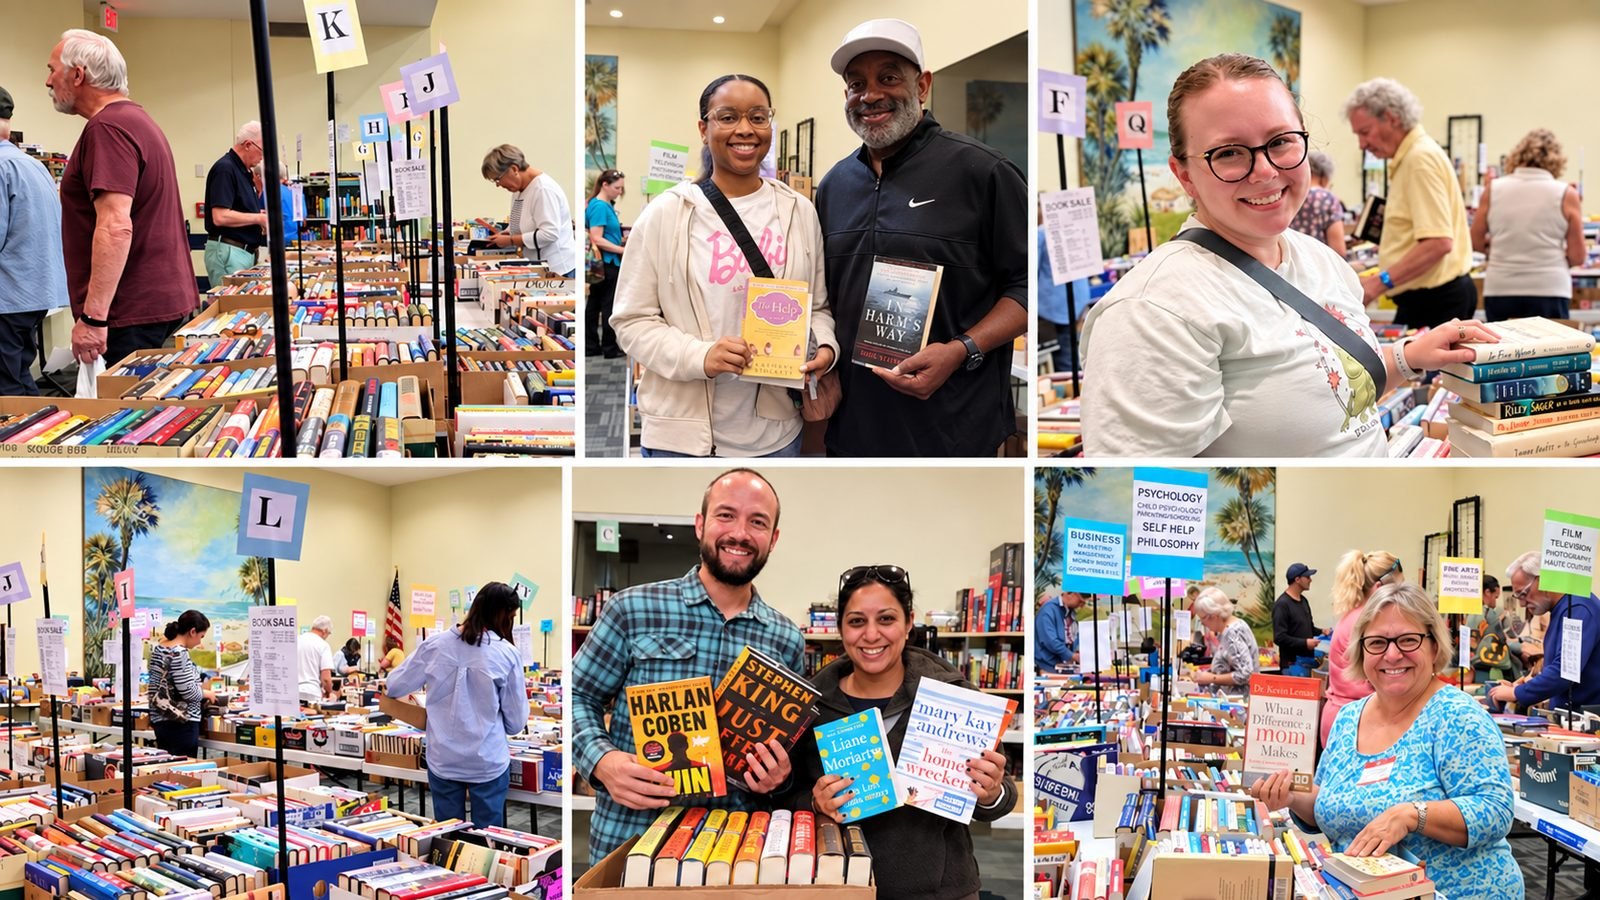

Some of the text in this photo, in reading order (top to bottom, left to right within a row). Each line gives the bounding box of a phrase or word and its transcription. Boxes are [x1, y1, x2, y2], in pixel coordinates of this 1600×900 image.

[317, 9, 349, 41] K
[422, 71, 436, 94] J
[1050, 89, 1069, 114] F
[367, 121, 381, 135] H
[1128, 114, 1147, 134] Q
[662, 151, 678, 159] FILM
[1045, 197, 1093, 213] BOOK SALE
[706, 226, 786, 285] Babi
[771, 301, 798, 317] Help
[865, 308, 922, 332] HARM'S
[876, 324, 907, 342] WAY
[1530, 401, 1555, 414] SAGER
[1137, 487, 1203, 504] PSYCHOLOGY
[256, 495, 282, 528] L
[602, 528, 613, 541] C
[1142, 521, 1195, 535] SELF HELP
[1561, 527, 1582, 539] FILM
[1070, 530, 1121, 545] BUSINESS
[1137, 536, 1200, 550] PHILOSOPHY
[1550, 538, 1592, 552] TELEVISION
[1460, 566, 1480, 574] ARTS
[1544, 559, 1566, 568] HAUTE
[2, 575, 12, 591] J
[120, 582, 129, 600] I
[251, 617, 295, 627] BOOK SALE
[745, 659, 814, 704] STEPHEN
[629, 686, 712, 716] HARLAN
[729, 672, 803, 724] KING
[1264, 701, 1294, 716] What
[642, 710, 708, 738] COBEN
[717, 699, 788, 745] JUST
[918, 703, 997, 736] mary kay
[1252, 714, 1312, 730] Difference a
[831, 734, 868, 753] Liane
[916, 721, 989, 748] andrews
[1255, 727, 1306, 745] mom
[922, 747, 966, 773] home
[1260, 744, 1299, 759] Makes
[905, 762, 973, 792] wreckers
